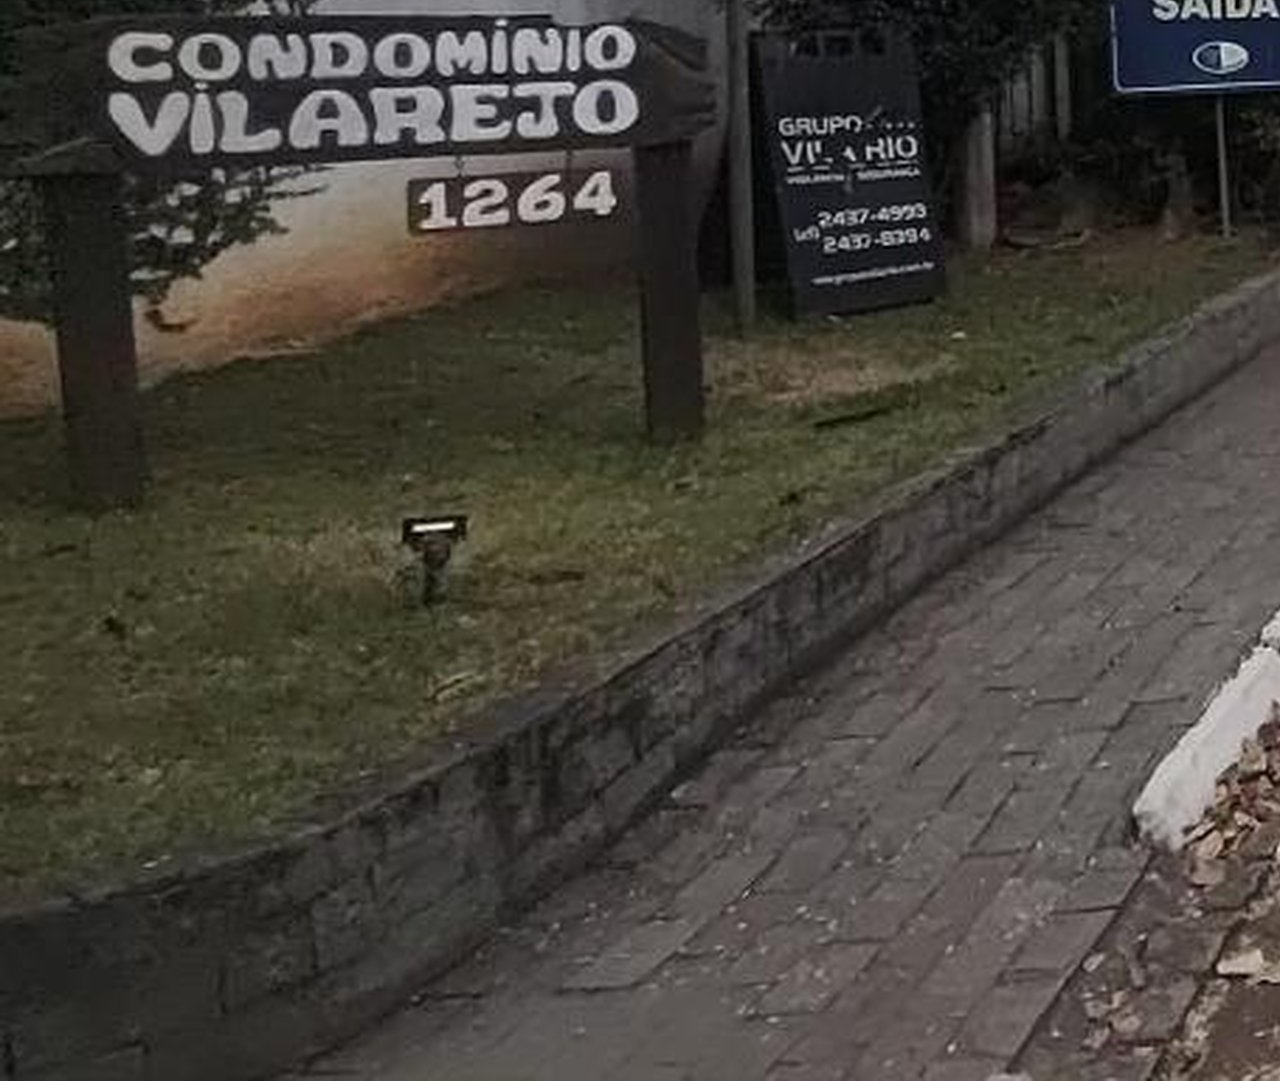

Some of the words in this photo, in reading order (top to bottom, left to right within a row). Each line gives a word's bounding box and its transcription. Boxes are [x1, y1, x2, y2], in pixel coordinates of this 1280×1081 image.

[107, 81, 640, 156] VILAREJO
[778, 115, 863, 137] GRUPO
[416, 170, 618, 230] 1264
